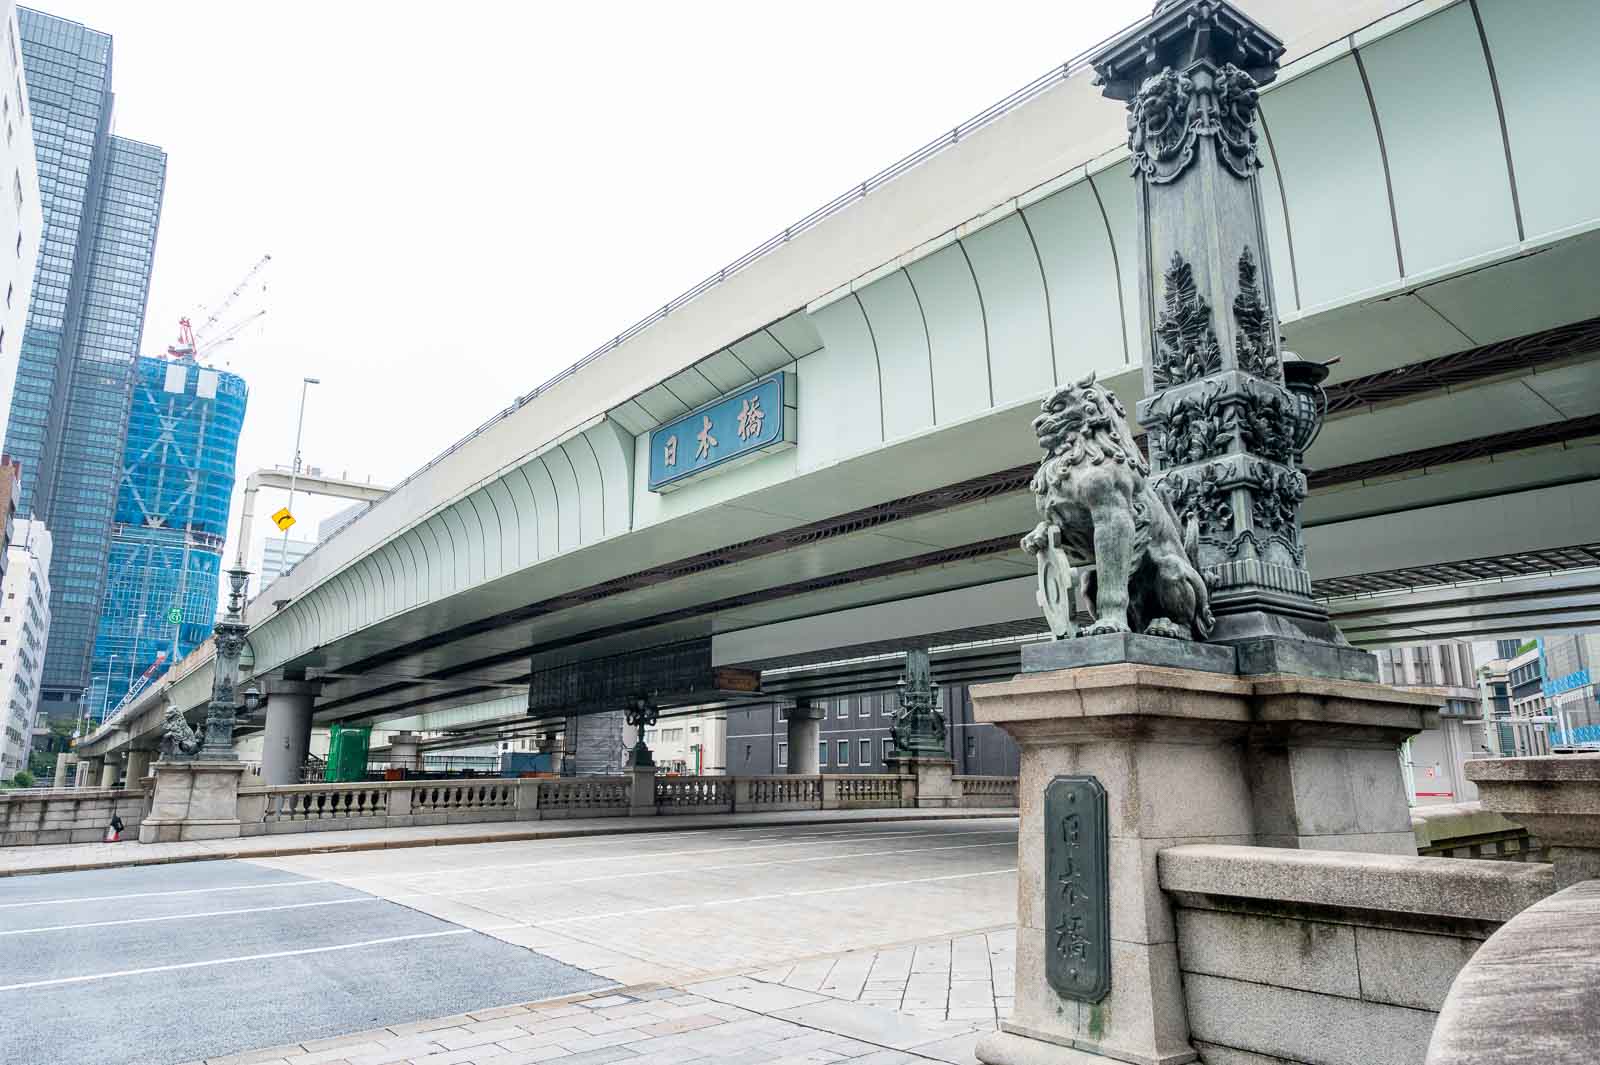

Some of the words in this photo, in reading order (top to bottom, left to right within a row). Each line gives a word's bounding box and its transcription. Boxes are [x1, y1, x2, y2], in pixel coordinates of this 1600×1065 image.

[664, 395, 765, 467] 日本橋
[1056, 813, 1091, 962] 日本橋
